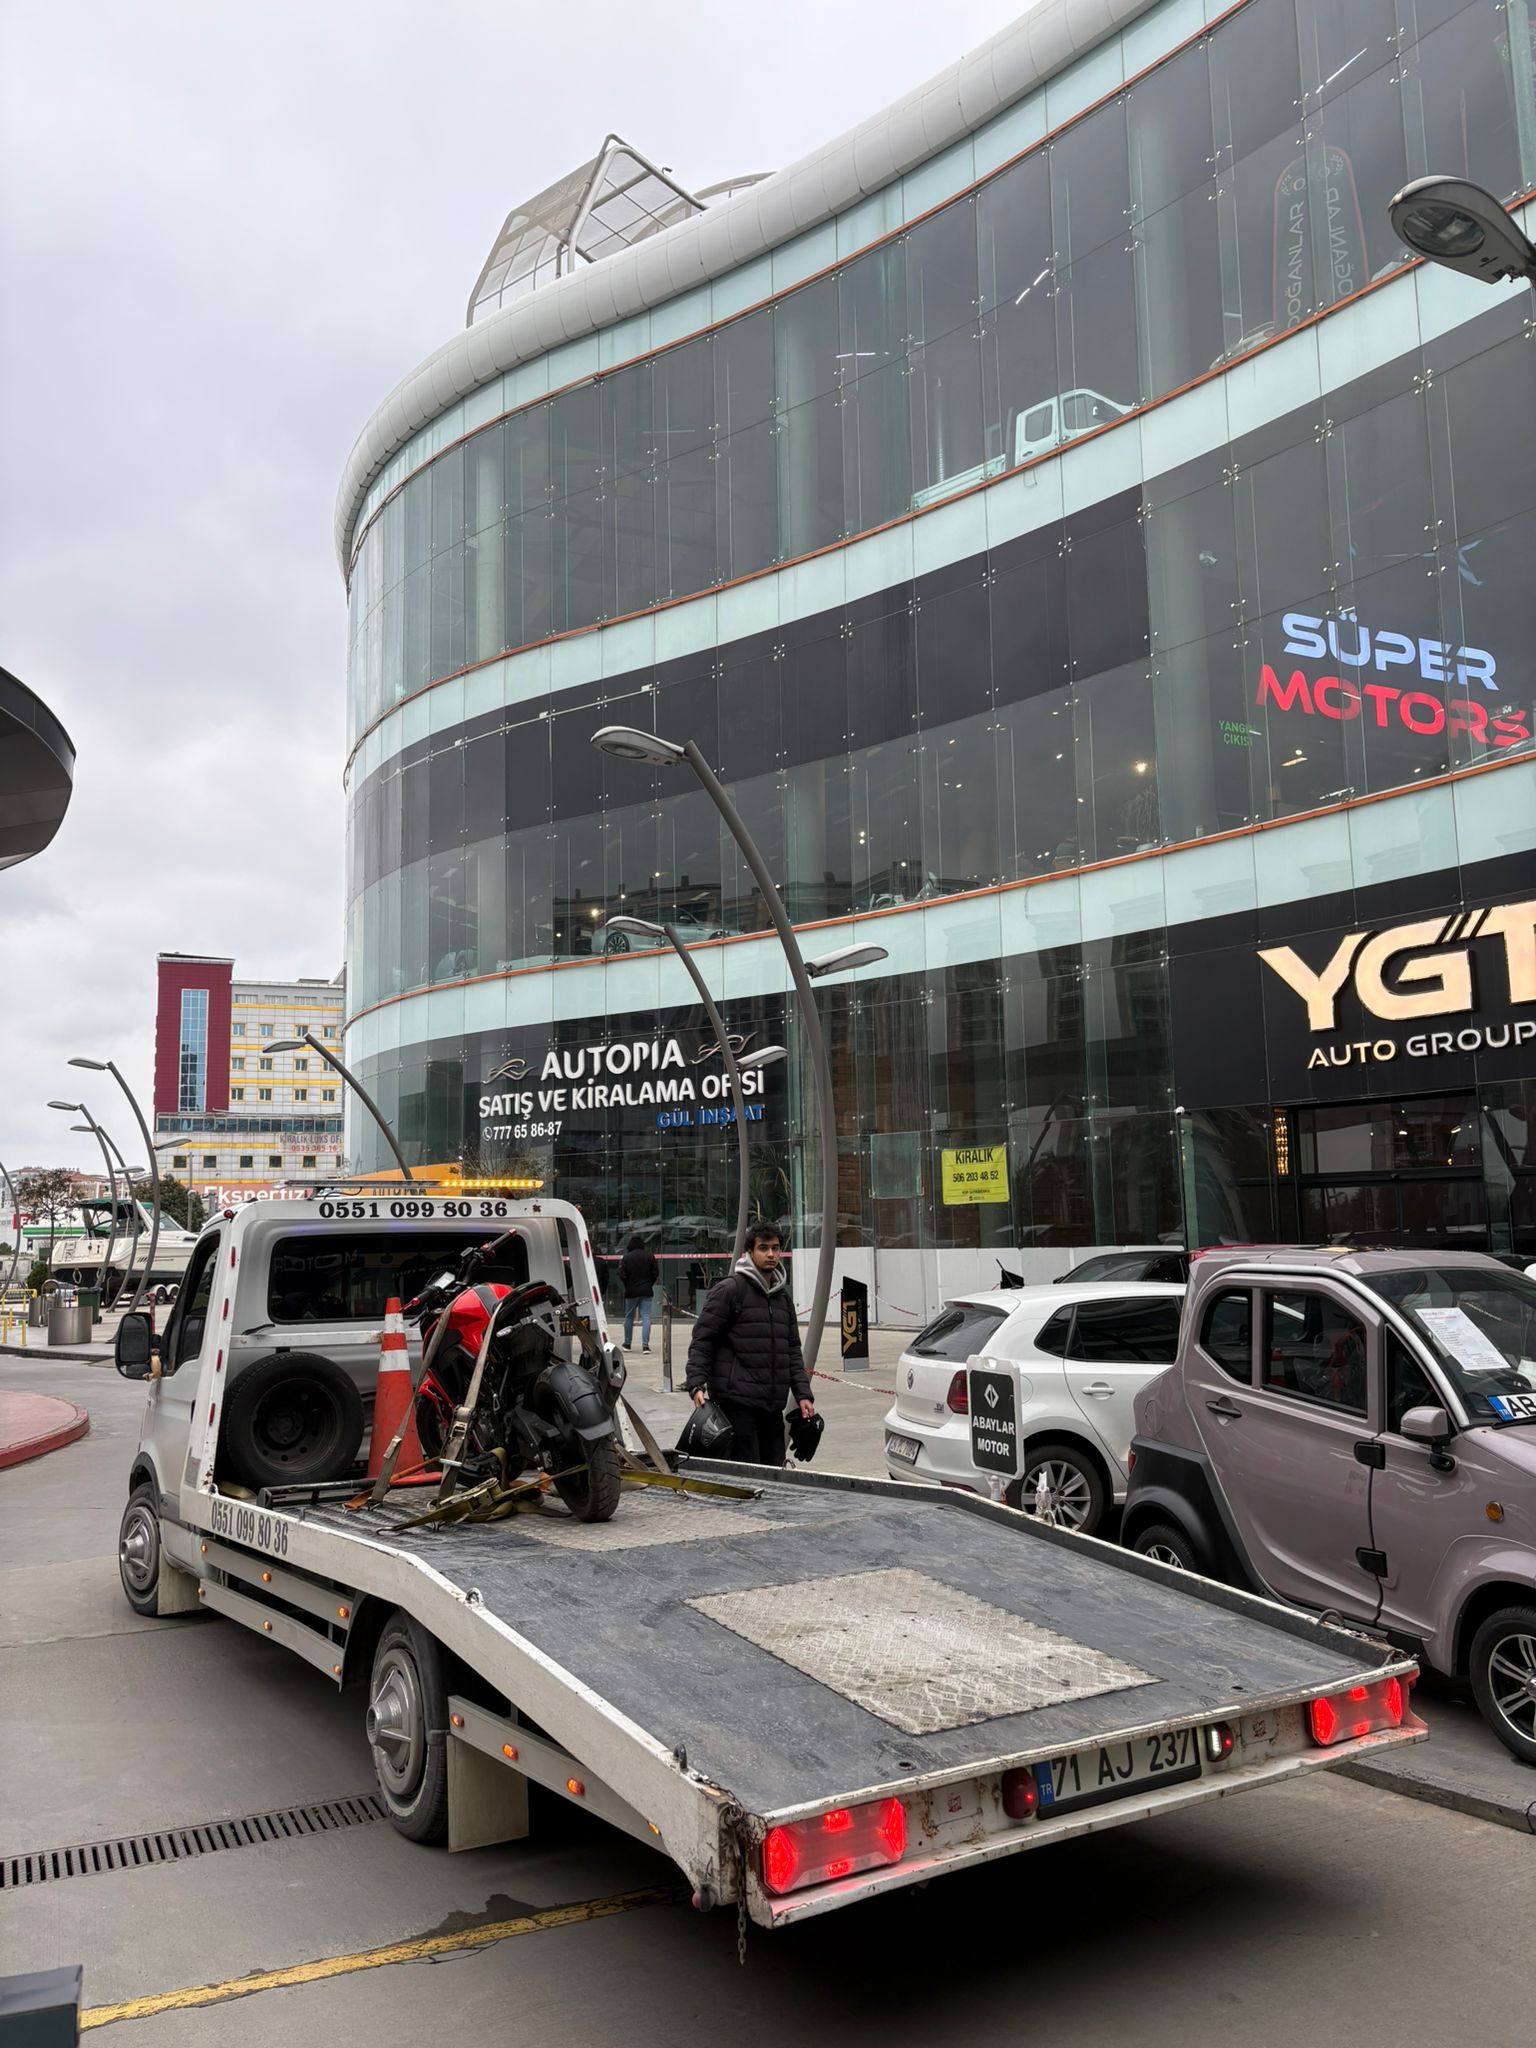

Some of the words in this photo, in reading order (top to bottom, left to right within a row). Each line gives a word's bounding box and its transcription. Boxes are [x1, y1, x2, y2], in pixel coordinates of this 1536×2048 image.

[1282, 612, 1499, 690] SÜPER
[1256, 664, 1530, 747] MOTORS
[1257, 900, 1536, 1032] YGT
[541, 1039, 685, 1081] AUTOPIA
[1307, 1040, 1396, 1069] AUTO
[1406, 1021, 1536, 1058] GROUP
[479, 1092, 533, 1120] SATIŞ
[538, 1089, 567, 1112] VE
[572, 1077, 696, 1110] KİRALAMA
[657, 1108, 694, 1127] GÜL
[493, 1125, 512, 1140] 777
[514, 1123, 528, 1139] 65
[530, 1120, 562, 1137] 86-87
[953, 1173, 965, 1183] 506
[966, 1172, 979, 1182] 203
[990, 1170, 999, 1180] 52
[319, 1201, 380, 1218] 0551
[390, 1201, 435, 1218] 099
[443, 1202, 472, 1217] 80
[480, 1201, 508, 1217] 36
[973, 1415, 1015, 1435] ABAYLAR
[977, 1437, 1010, 1457] MOTOR
[212, 1500, 233, 1535] 0551
[237, 1508, 254, 1543] 099
[258, 1515, 271, 1549] 80
[274, 1519, 288, 1555] 36
[1052, 1754, 1081, 1797] 71
[1098, 1741, 1133, 1786] AJ
[1147, 1729, 1190, 1773] 237
[1041, 1784, 1053, 1796] TR
